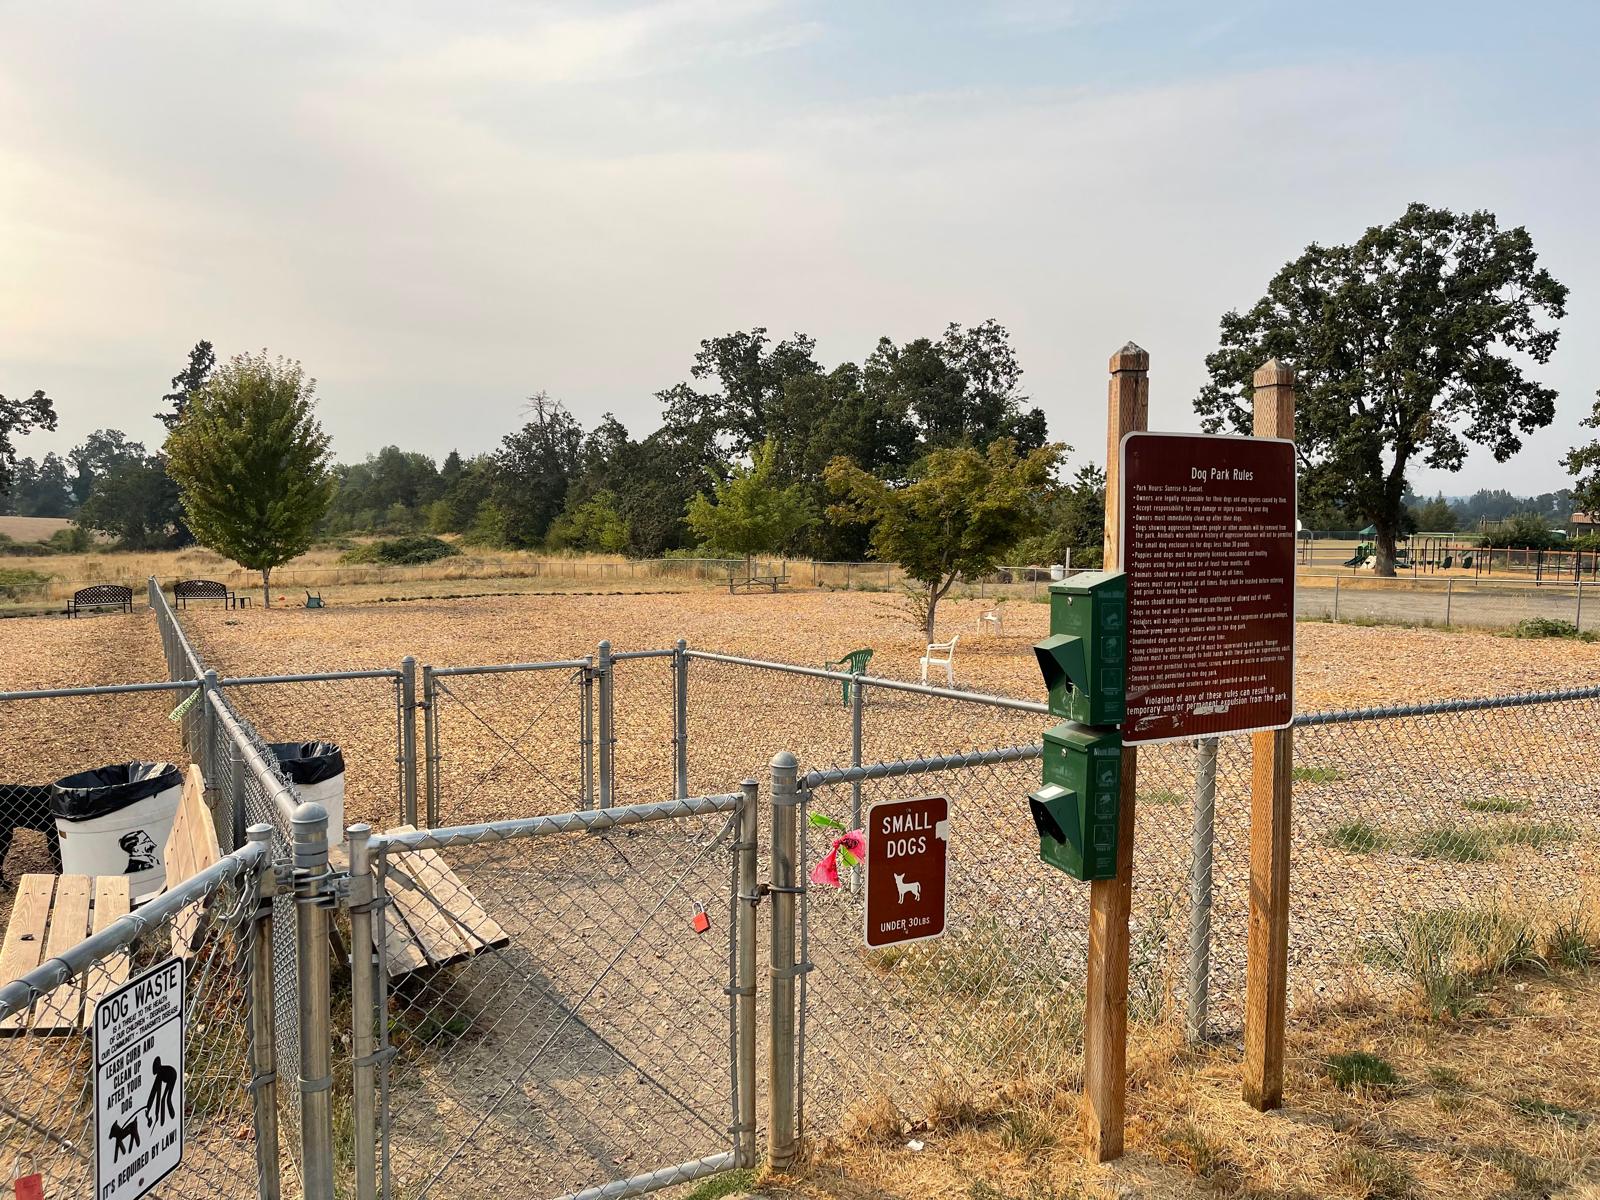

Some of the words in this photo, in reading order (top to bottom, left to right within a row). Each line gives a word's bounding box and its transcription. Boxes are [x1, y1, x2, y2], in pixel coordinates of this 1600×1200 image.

[1192, 467, 1207, 483] Dog
[1211, 467, 1229, 480] Park
[1233, 468, 1253, 481] Rules
[1127, 706, 1161, 716] temporary
[1163, 703, 1184, 712] and/or
[1186, 700, 1218, 712] permanent
[1220, 697, 1248, 706] expulsion
[1250, 695, 1263, 704] from
[1264, 694, 1274, 702] the
[1144, 696, 1174, 704] Violation
[1176, 693, 1183, 702] of
[1184, 694, 1196, 702] any
[1198, 692, 1204, 700] of
[1206, 691, 1222, 700] these
[1224, 689, 1239, 698] rules
[1252, 686, 1268, 695] result
[882, 812, 932, 834] SMALL
[887, 836, 926, 858] DOGS
[880, 919, 906, 932] UNDER
[103, 994, 128, 1030] DOG
[135, 966, 177, 1009] WASTE
[110, 1036, 115, 1045] OF
[116, 1030, 125, 1041] OUR
[126, 1017, 145, 1034] CHILDREN
[150, 1001, 170, 1019] DEGRADES
[113, 1025, 118, 1034] IS
[122, 1013, 137, 1027] THREAT
[138, 1009, 144, 1017] TO
[153, 995, 168, 1010] HEALTH
[102, 1048, 110, 1060] OUR
[111, 1033, 135, 1054] COMMUNITY
[140, 1016, 161, 1034] TRANSMITS
[162, 1005, 178, 1021] DISEASE
[106, 1056, 124, 1080] LEASH
[126, 1045, 141, 1066] CURB
[143, 1036, 155, 1054] AND
[114, 1066, 132, 1090] CLEAN
[134, 1060, 142, 1075] UP
[107, 1086, 125, 1110] AFTER
[127, 1074, 142, 1095] YOUR
[121, 1095, 133, 1115] DOG
[103, 1178, 115, 1200] IT'S
[118, 1151, 149, 1188] REQUIRED
[152, 1142, 160, 1160] BY
[162, 1128, 177, 1152] LAW!
